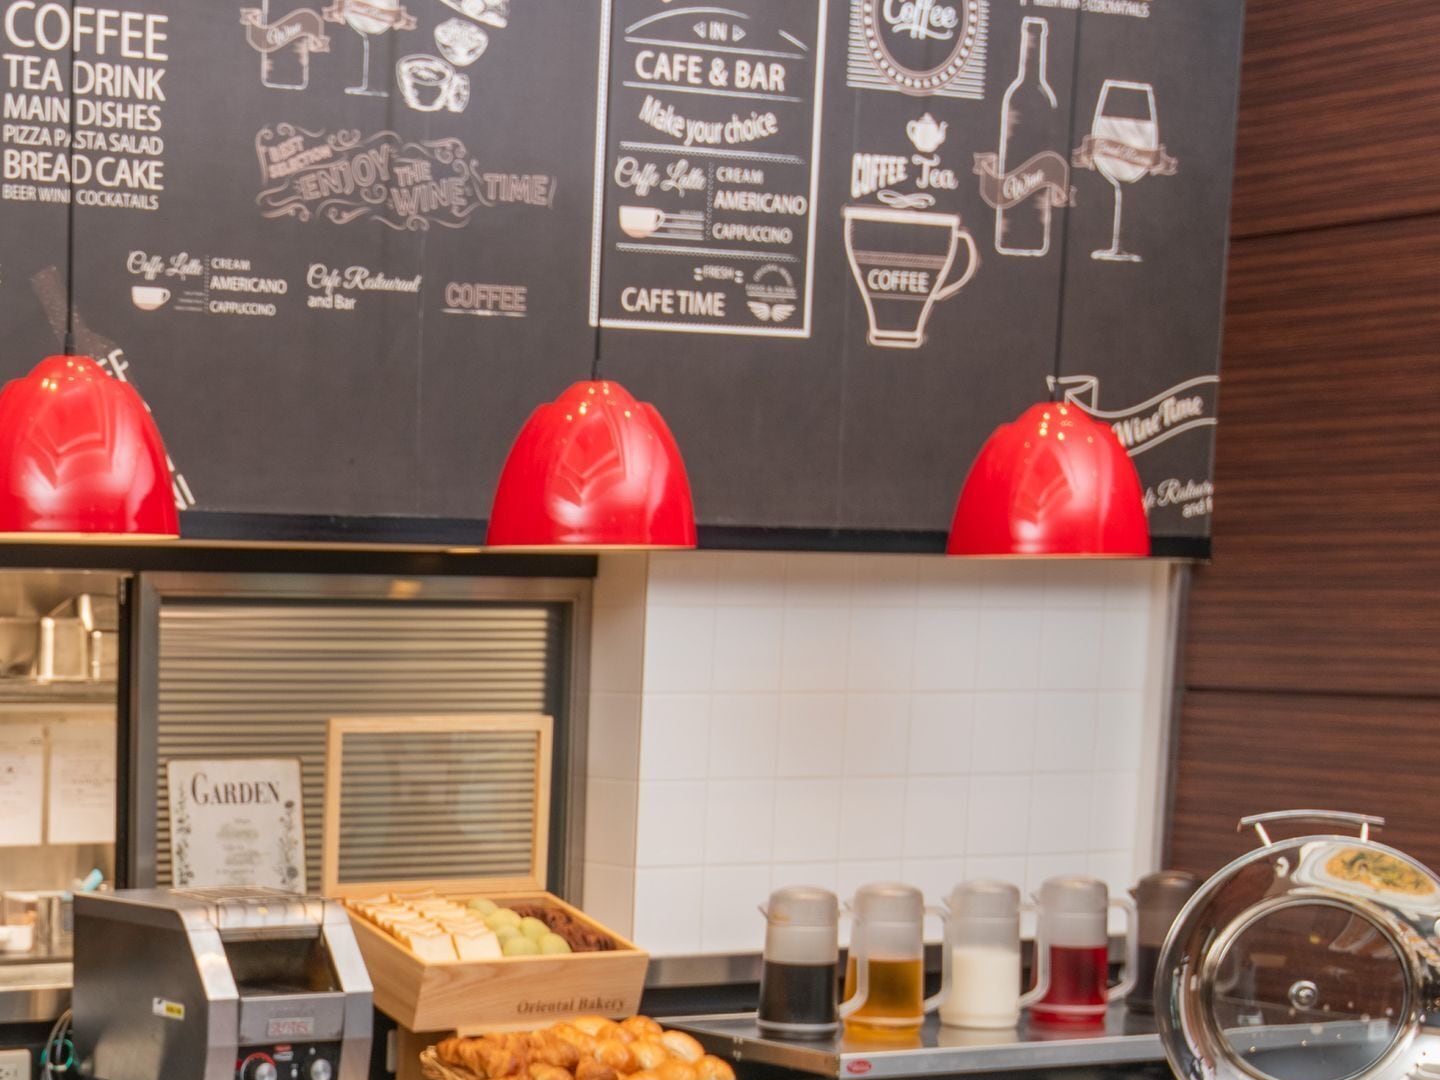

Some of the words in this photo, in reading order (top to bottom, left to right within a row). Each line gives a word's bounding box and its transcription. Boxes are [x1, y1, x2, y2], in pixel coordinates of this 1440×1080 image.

[4, 0, 169, 62] COFFEE
[709, 20, 728, 42] IN
[883, 0, 959, 40] Coffee
[2, 53, 64, 93] TEA
[72, 59, 167, 103] DRINK
[634, 50, 703, 84] CAFE
[708, 56, 728, 87] &
[734, 60, 786, 92] BAR
[3, 92, 70, 125] MAIN
[76, 98, 162, 133] DISHES
[638, 94, 687, 139] Make
[684, 117, 724, 146] your
[724, 110, 778, 145] choice
[2, 123, 52, 147] PIZZA
[109, 131, 164, 156] SALAD
[3, 148, 93, 186] BREAD
[95, 153, 165, 191] CAKE
[298, 143, 391, 201] ENJOY
[392, 160, 433, 188] THE
[715, 165, 764, 185] CREAM
[911, 153, 960, 190] Tea
[2, 183, 37, 202] BEER
[75, 188, 160, 211] COCKATAILS
[390, 177, 468, 217] WINE
[713, 190, 808, 216] AMERICANO
[711, 222, 793, 245] CAPPUCCINO
[210, 257, 252, 272] CREAM
[306, 263, 342, 294] Cafe
[343, 265, 423, 293] Restaurant
[210, 275, 289, 295] AMERICANO
[867, 267, 931, 294] COFFEE
[209, 300, 277, 317] CAPPUCCINO
[307, 294, 333, 310] and
[334, 293, 357, 310] Bar
[444, 281, 528, 312] COFFEE
[620, 286, 674, 315] CAFE
[675, 289, 727, 317] TIME
[191, 772, 281, 807] GARDEN
[516, 998, 575, 1015] Oriental
[578, 996, 625, 1014] Bakery
